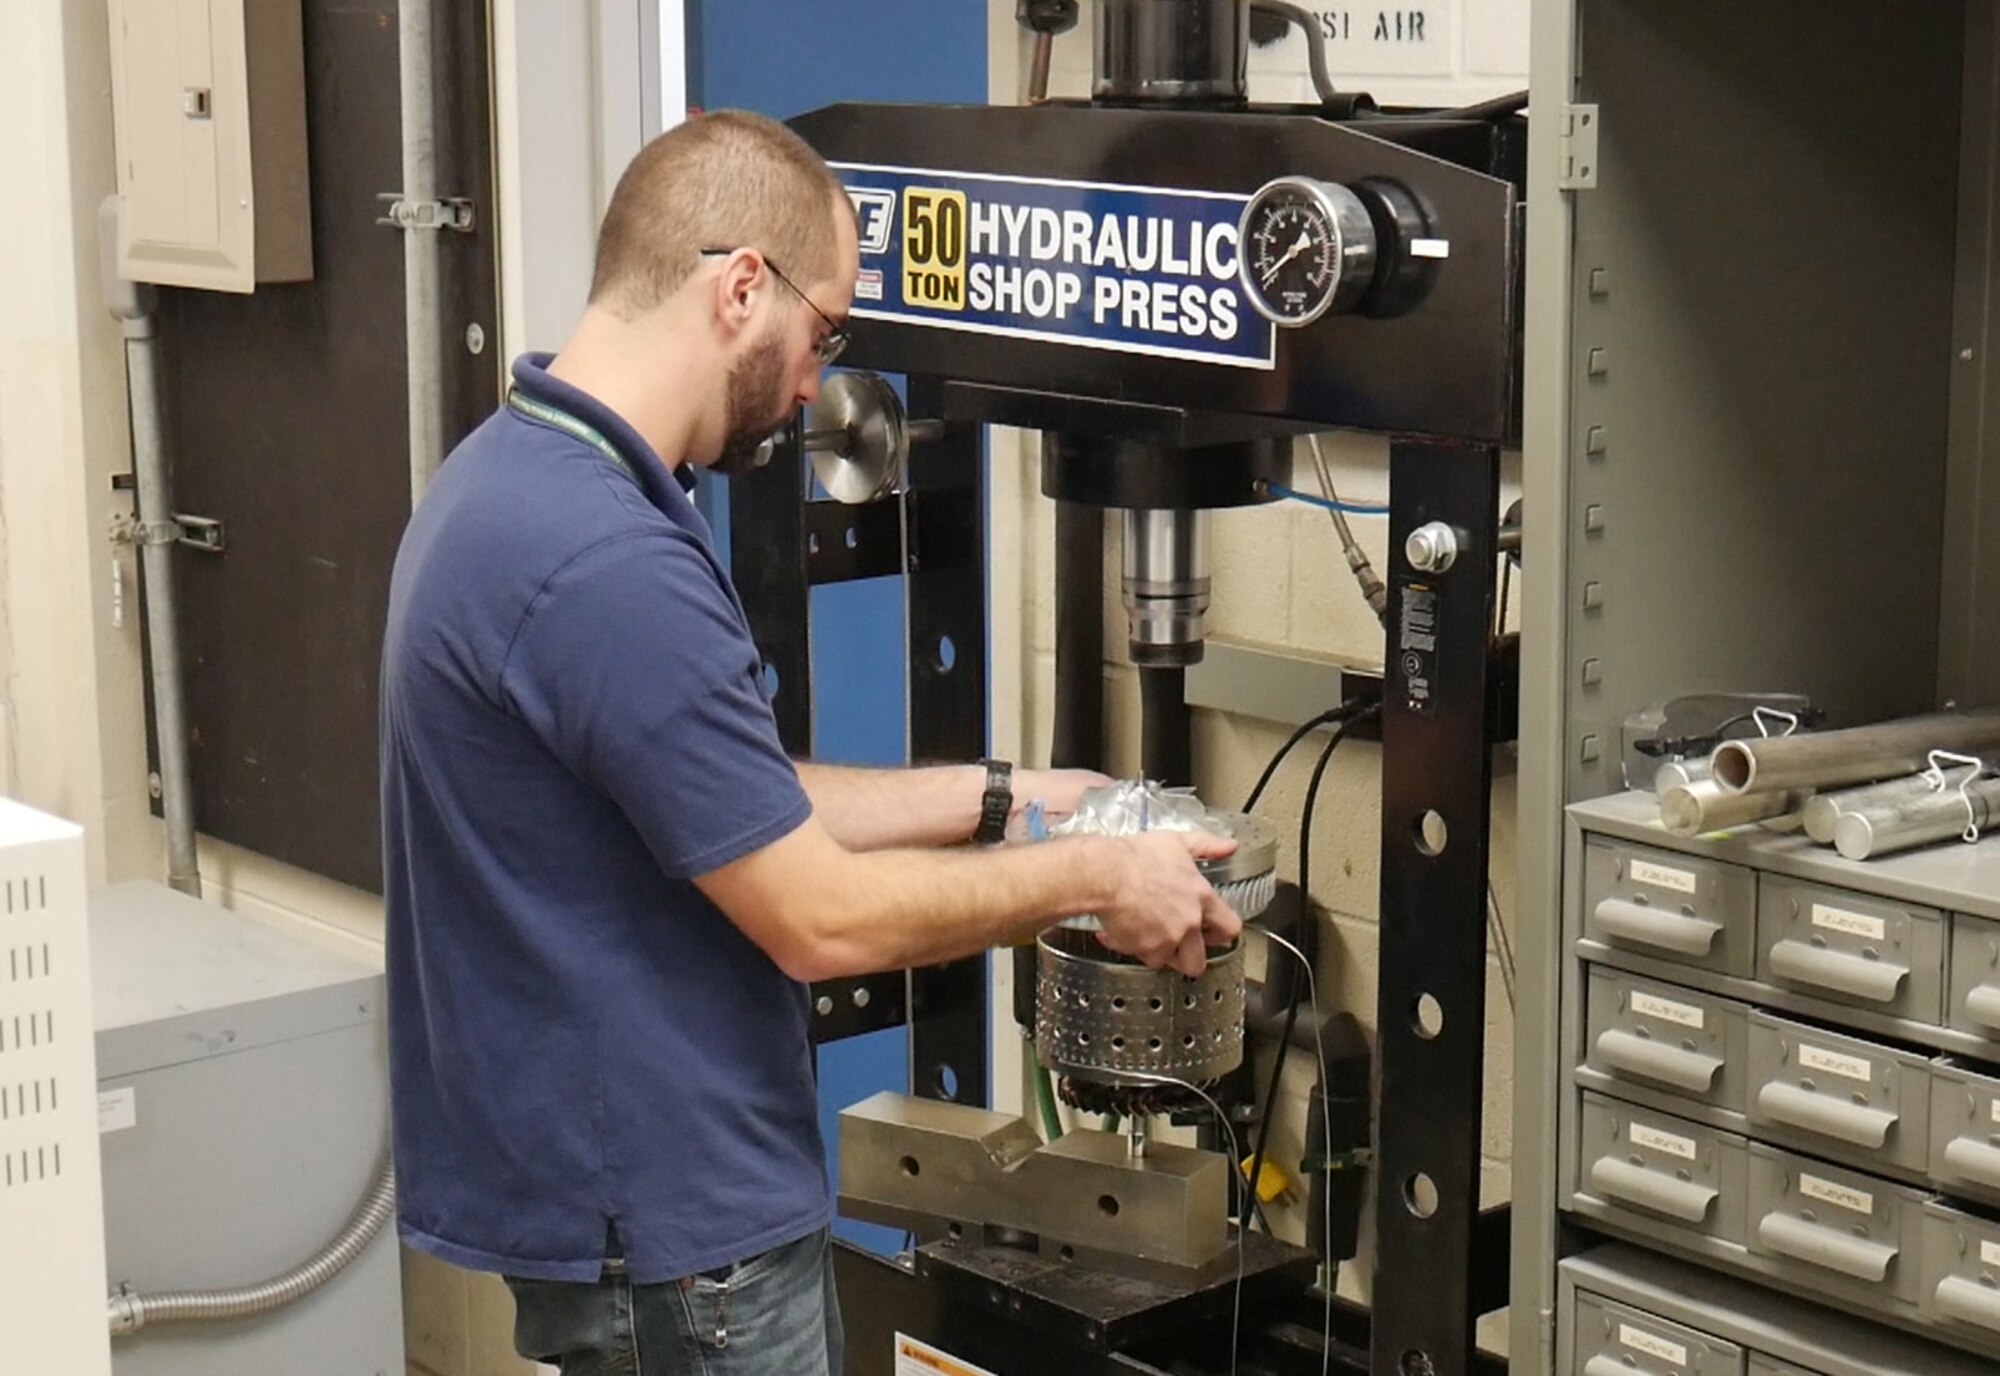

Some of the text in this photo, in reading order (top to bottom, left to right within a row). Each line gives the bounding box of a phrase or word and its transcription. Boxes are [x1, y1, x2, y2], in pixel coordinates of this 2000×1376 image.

[1373, 11, 1425, 41] AIR
[908, 195, 962, 268] 50
[970, 202, 1238, 280] HYDRAULIC
[907, 271, 960, 303] TON
[968, 262, 1238, 341] SHOP PRESS
